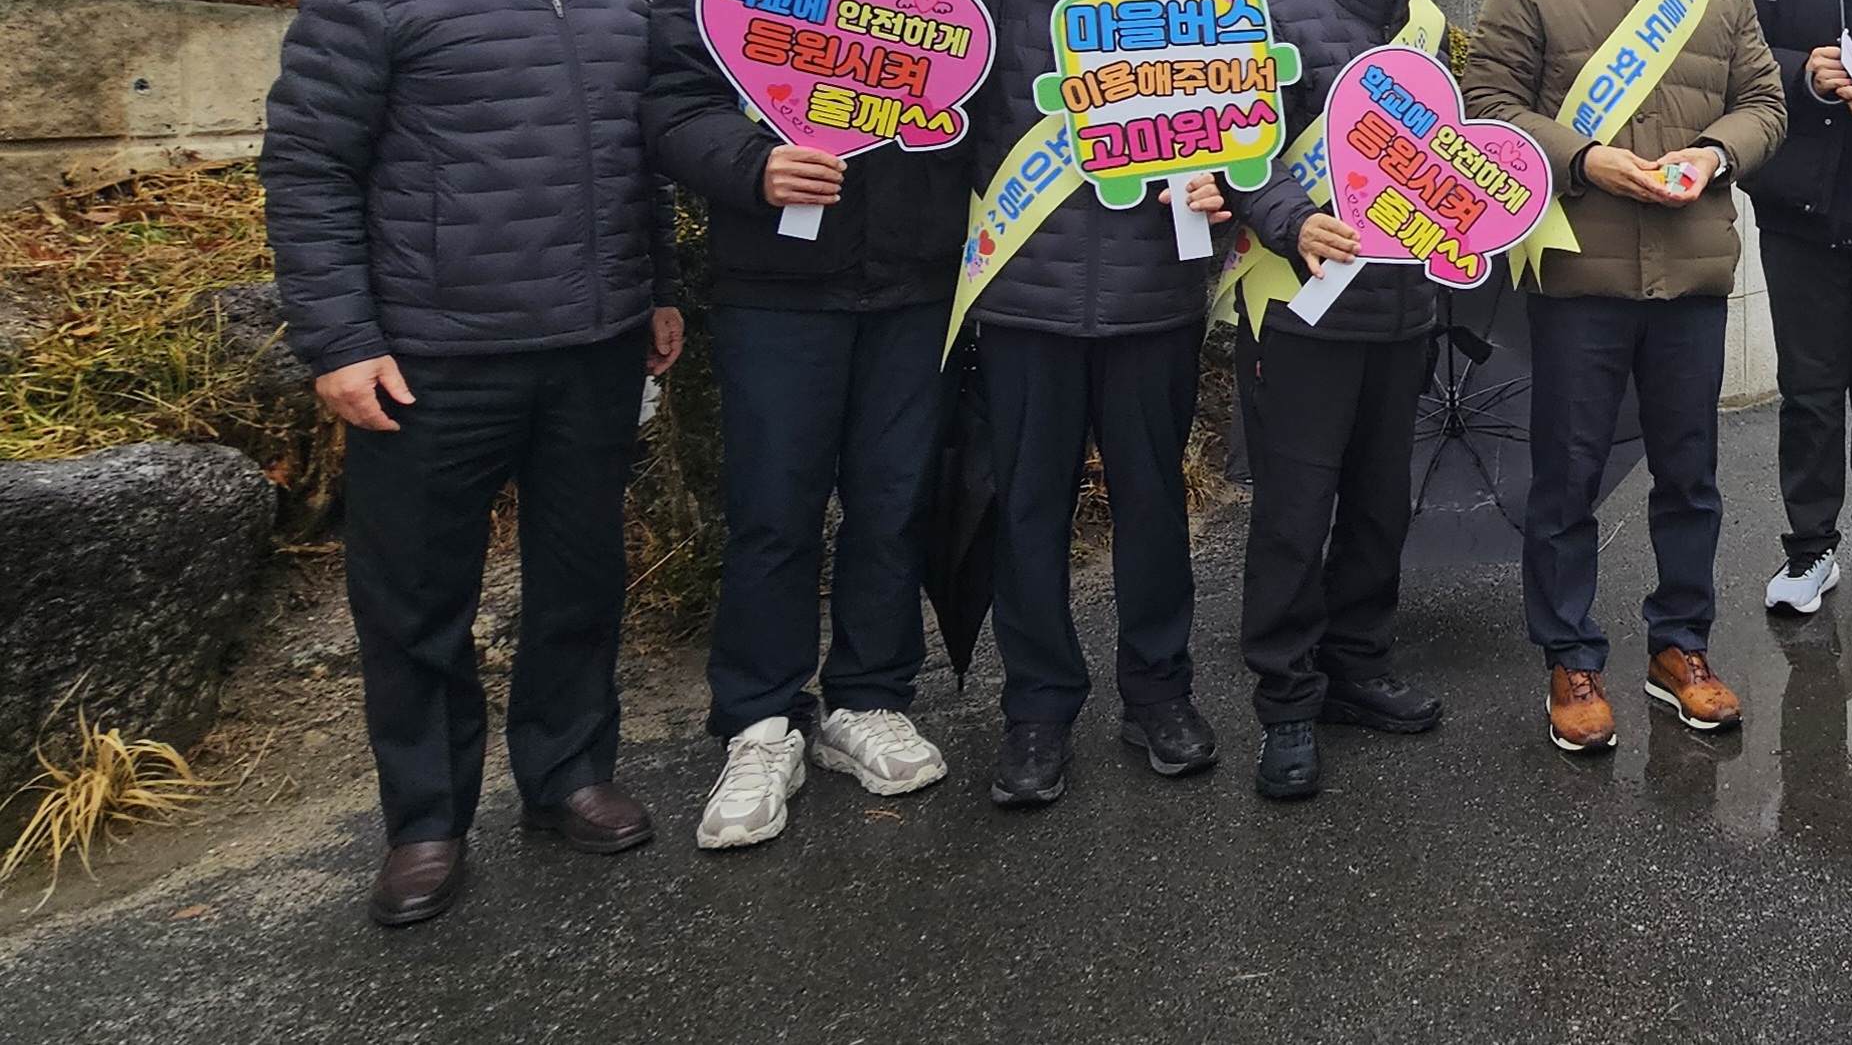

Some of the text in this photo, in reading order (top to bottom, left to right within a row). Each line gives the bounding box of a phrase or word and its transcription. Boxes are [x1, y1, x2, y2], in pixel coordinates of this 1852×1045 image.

[742, 18, 932, 97] 등원시켜
[1060, 56, 1278, 113] 이용해주어서
[1571, 46, 1647, 139] 화이팅
[1077, 99, 1279, 173] 고마워^^
[1346, 110, 1488, 235] 등원시켜
[1359, 64, 1532, 216] 학교에 안전하게
